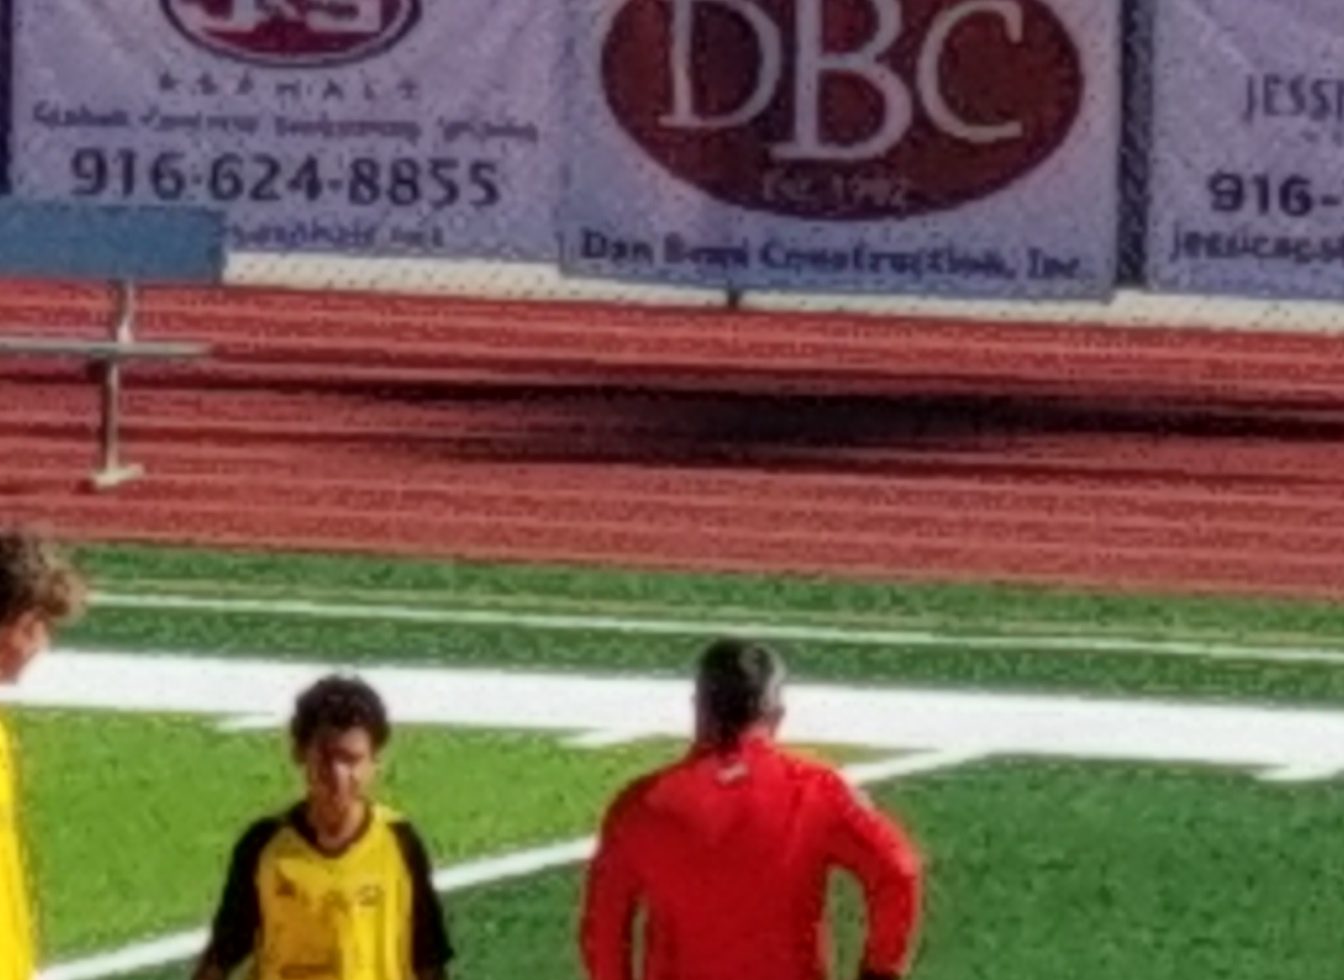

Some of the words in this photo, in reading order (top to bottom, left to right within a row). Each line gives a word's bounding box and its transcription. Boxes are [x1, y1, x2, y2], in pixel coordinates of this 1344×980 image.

[656, 0, 1024, 160] DBC
[70, 148, 502, 206] 916-624-8855
[580, 228, 654, 266] Dan
[760, 237, 1017, 280] Construction,
